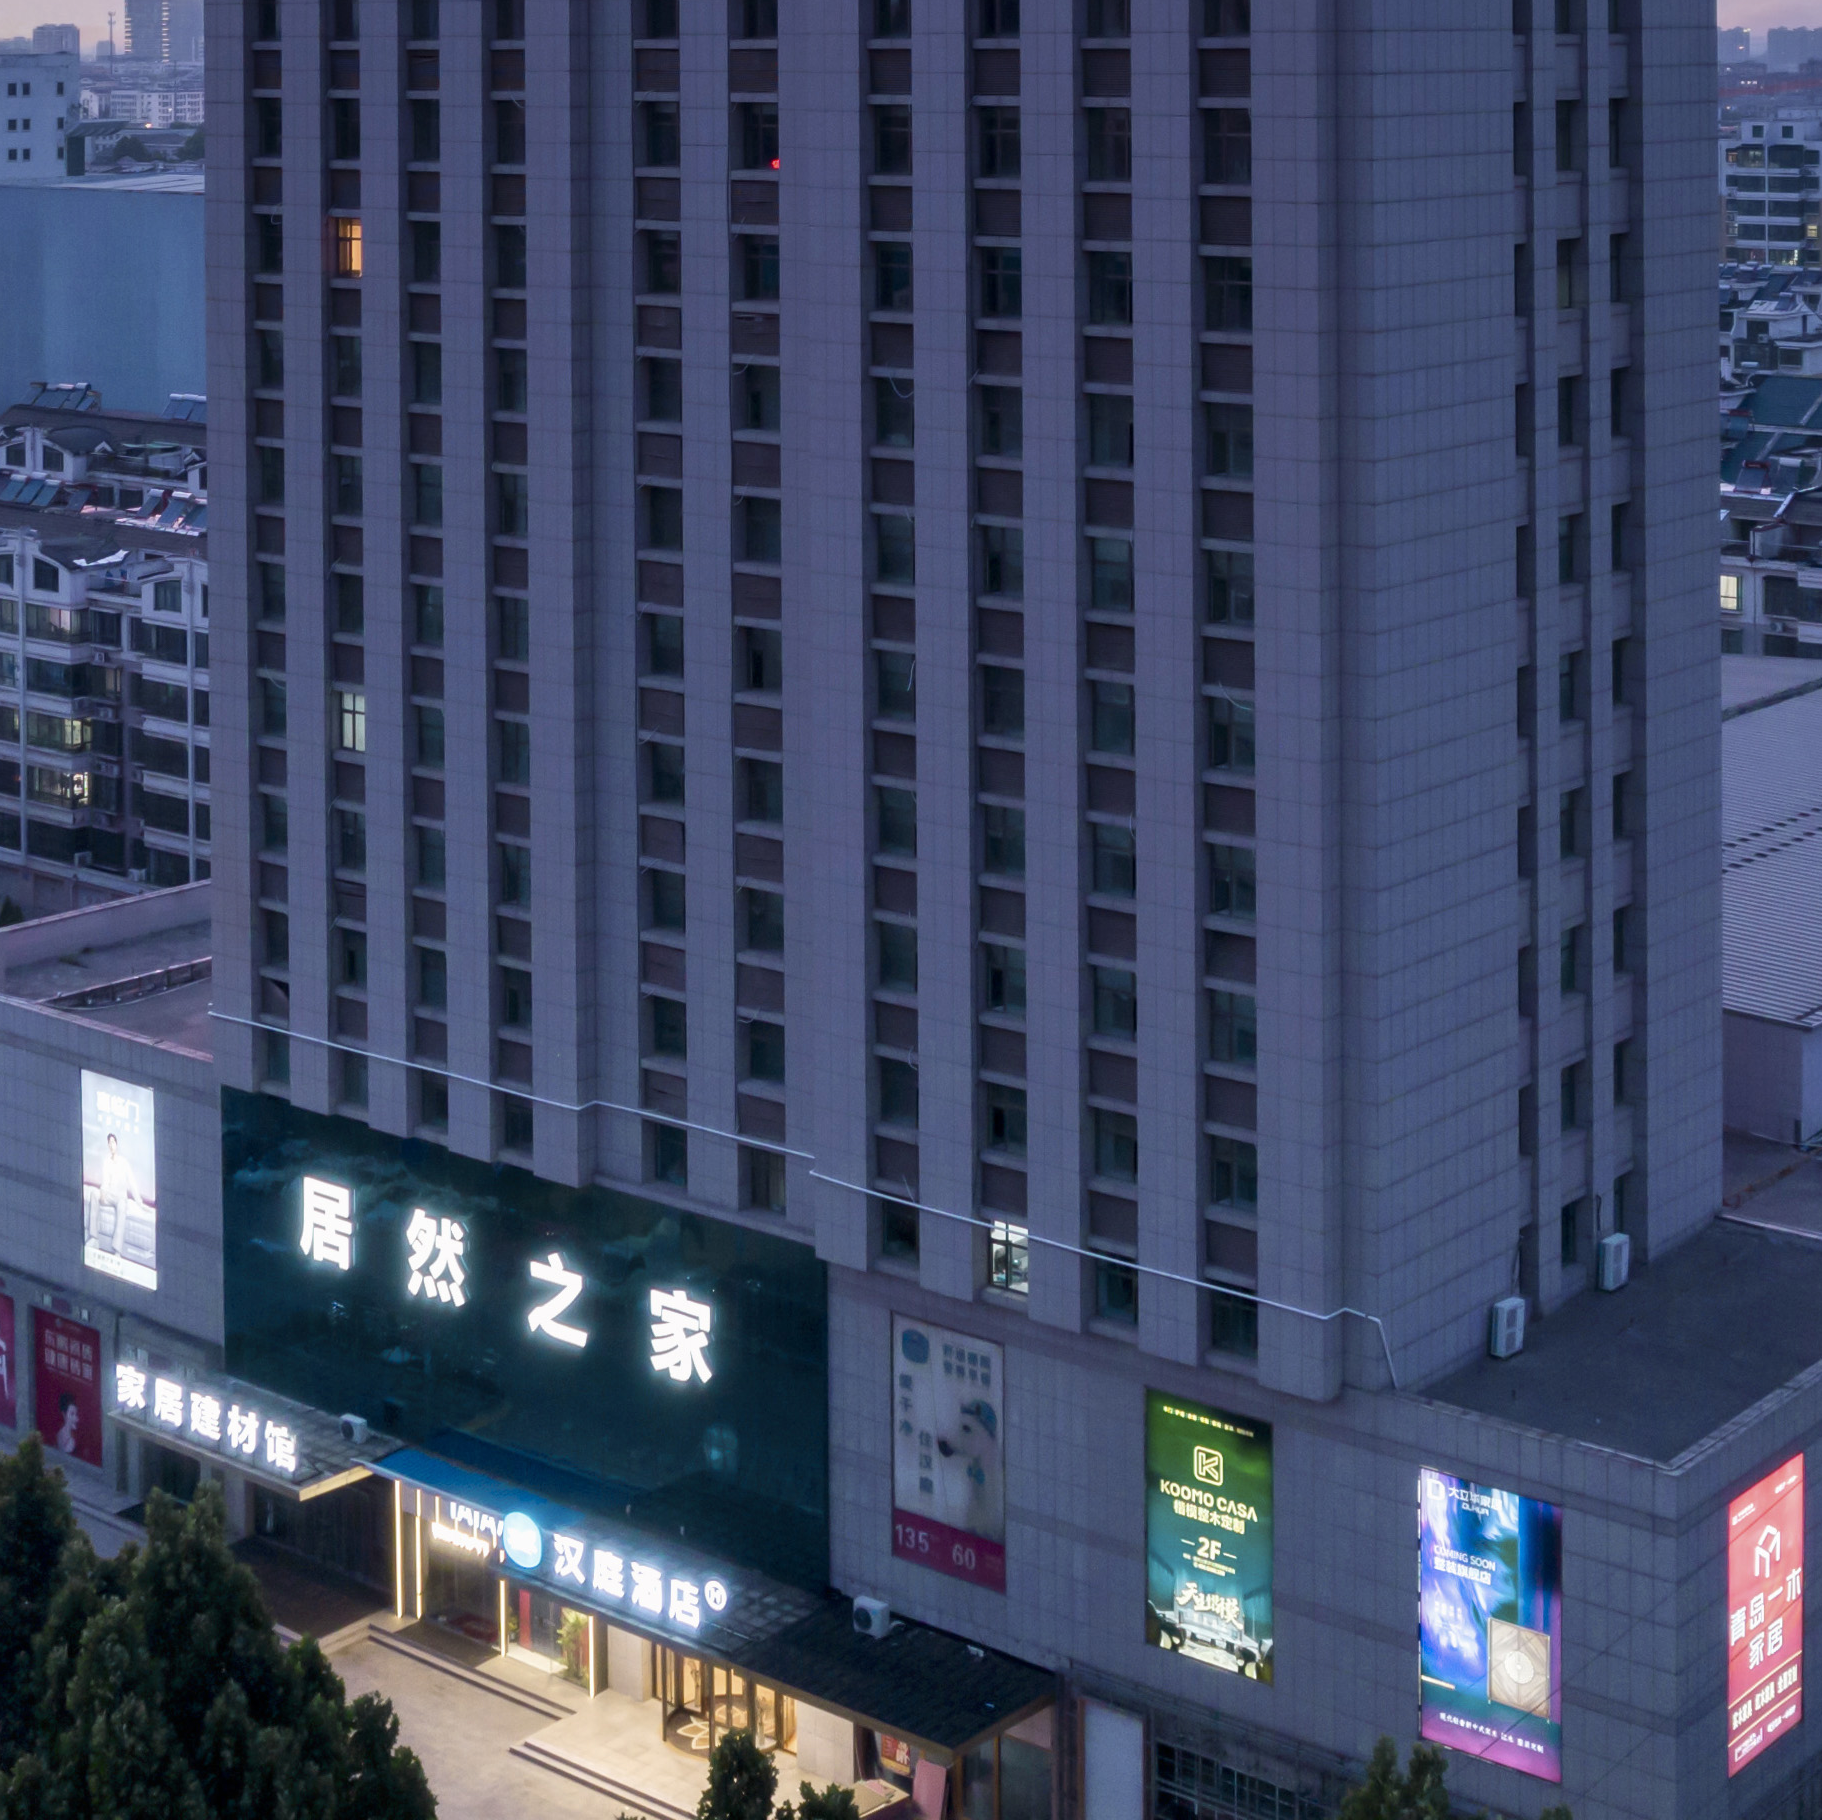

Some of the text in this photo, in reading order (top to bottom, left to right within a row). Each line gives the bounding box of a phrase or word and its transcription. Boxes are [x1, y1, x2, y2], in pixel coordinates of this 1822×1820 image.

[299, 1175, 713, 1384] 居然之家
[115, 1363, 297, 1473] 家居建材馆
[1159, 1478, 1258, 1523] KOOMO CASA
[895, 1523, 930, 1554] 135
[952, 1543, 977, 1571] 60
[1196, 1536, 1222, 1561] 2F
[1433, 1544, 1496, 1572] COMING SOON
[553, 1532, 701, 1629] 汉庭酒店
[1748, 1615, 1784, 1670] 家居
